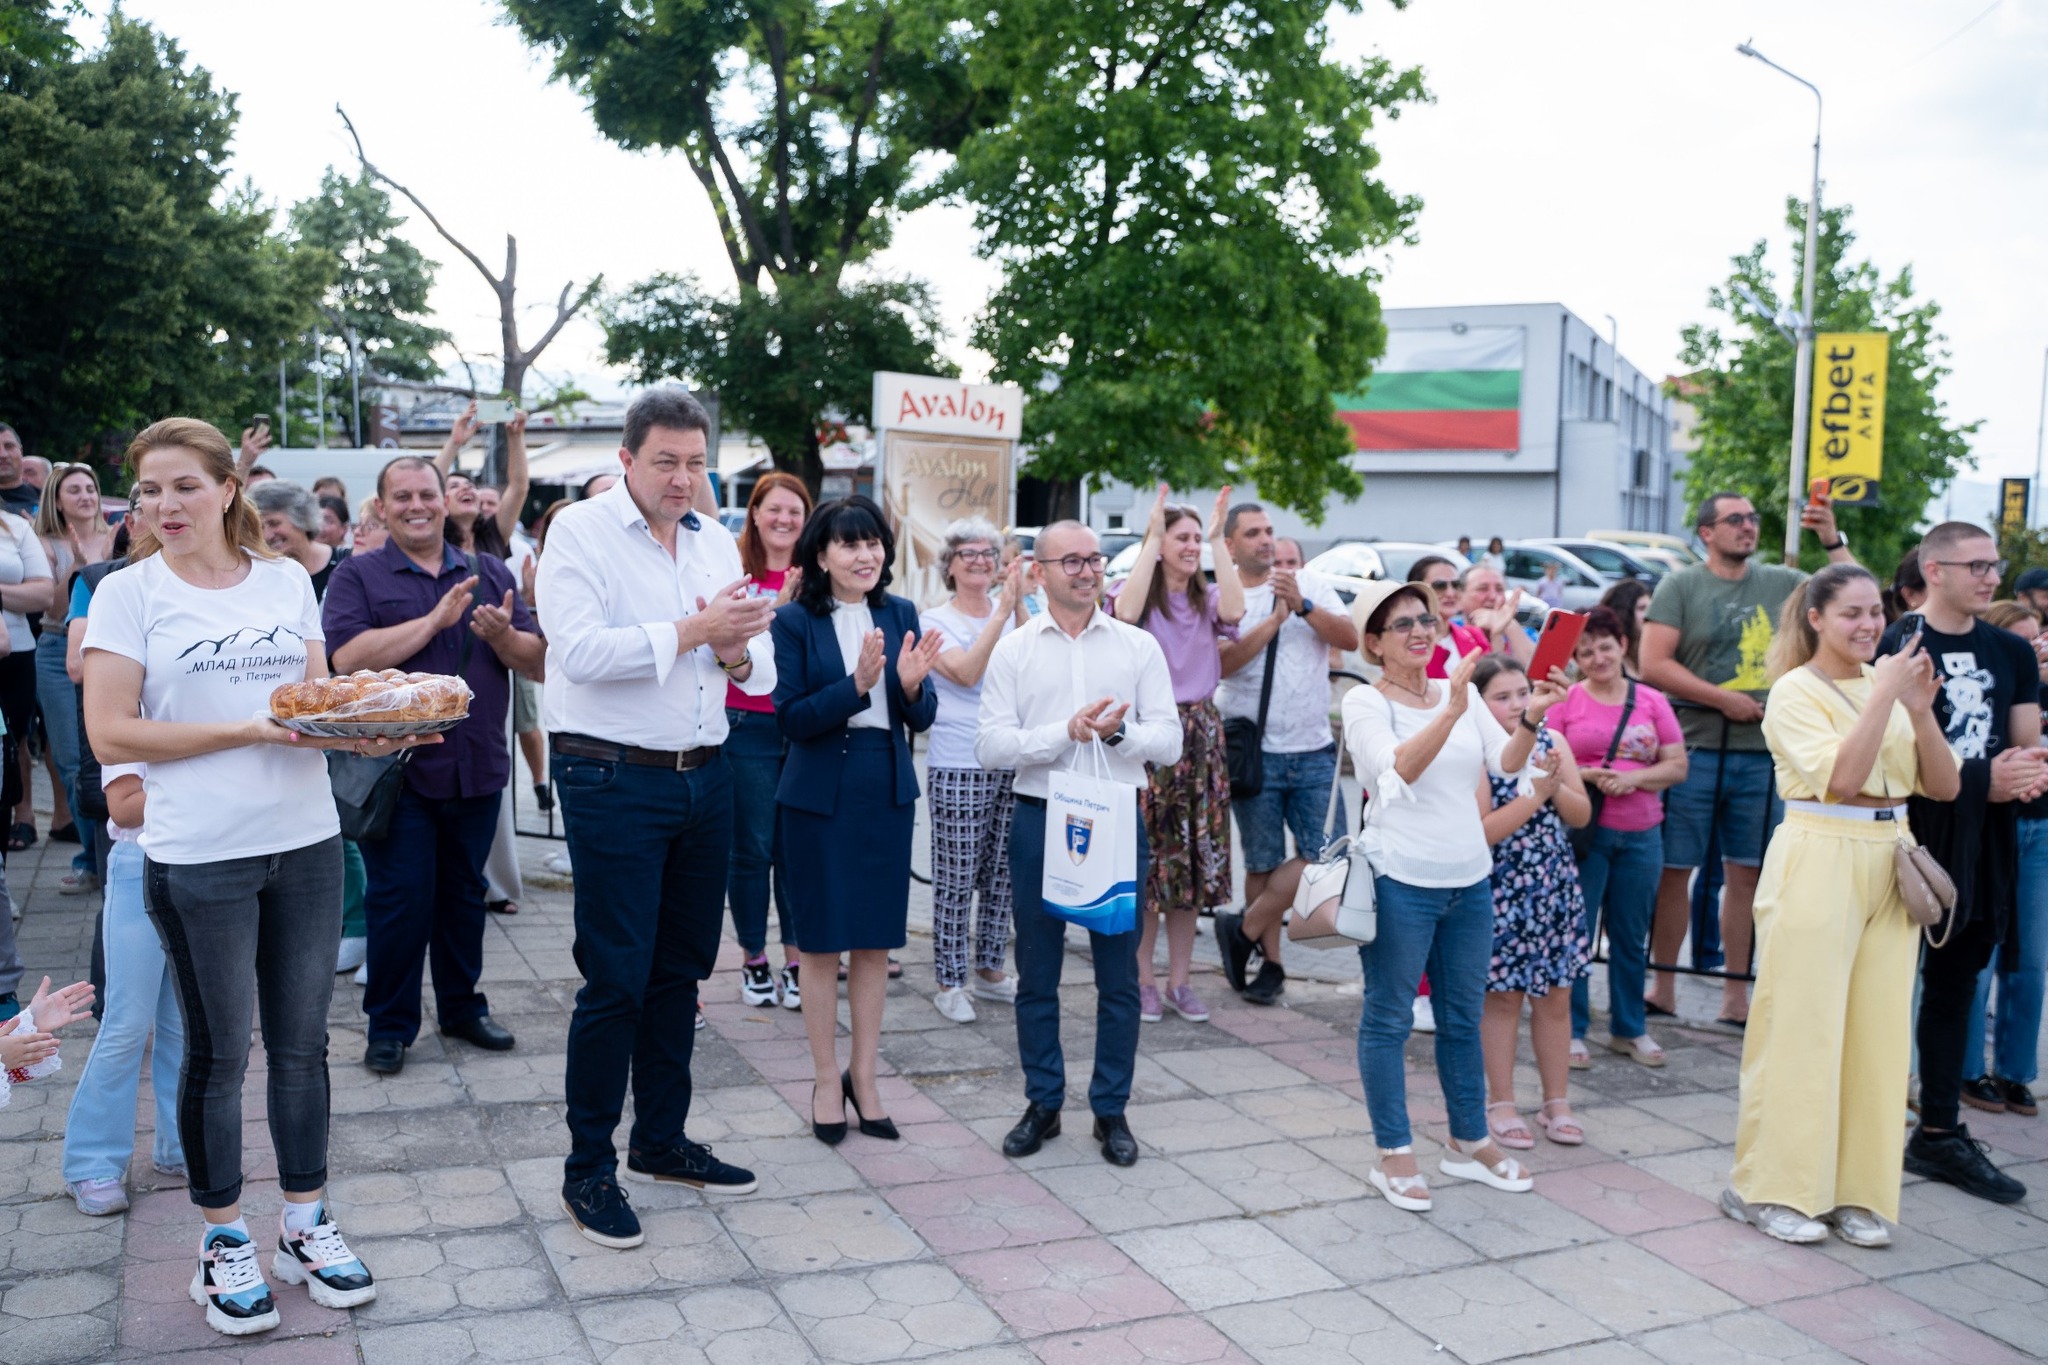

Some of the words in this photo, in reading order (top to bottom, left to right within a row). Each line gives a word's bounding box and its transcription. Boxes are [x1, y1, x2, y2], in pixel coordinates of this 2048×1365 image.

[898, 386, 1006, 431] Avalon
[1821, 344, 1855, 460] efbet
[1858, 371, 1876, 440] ЛИГА
[903, 451, 989, 479] Avalon
[229, 675, 242, 685] гр.
[246, 671, 281, 681] Петрич
[1054, 792, 1082, 806] Община
[1084, 799, 1110, 812] Петрич
